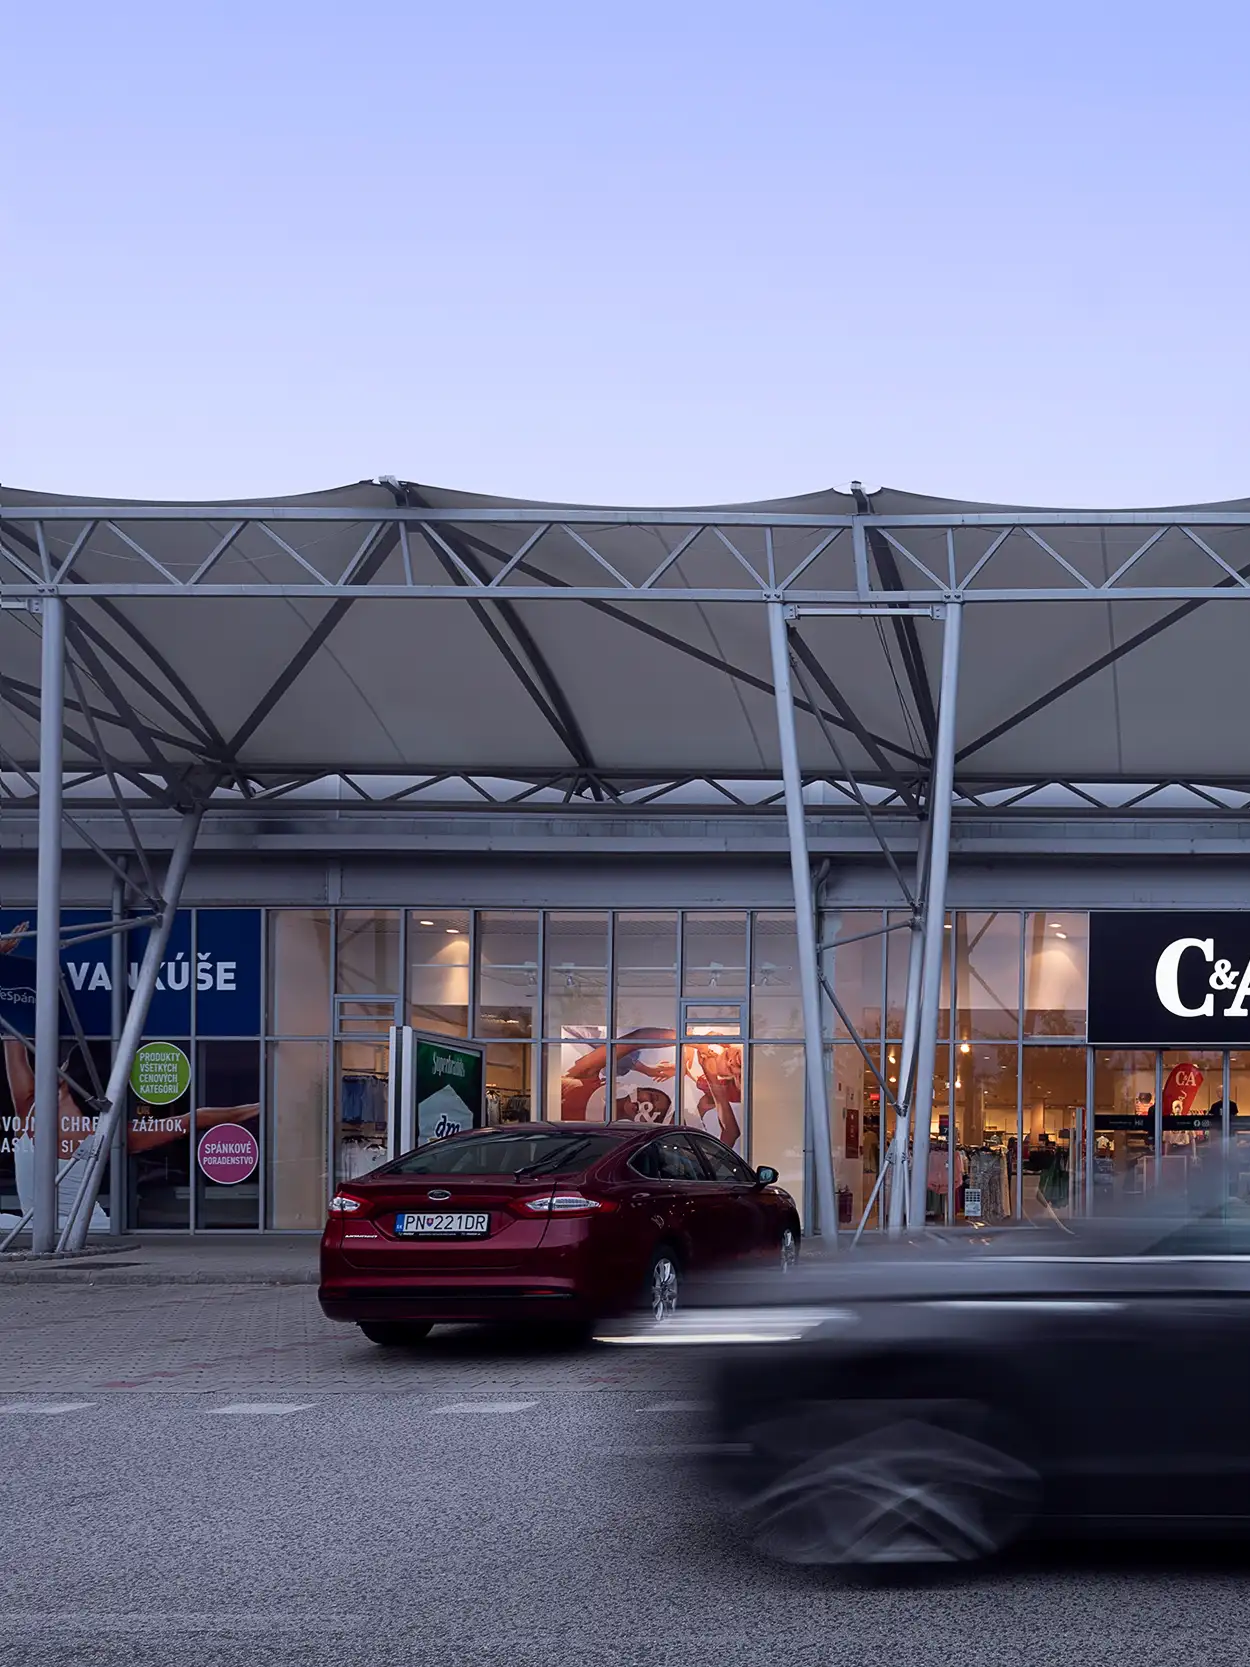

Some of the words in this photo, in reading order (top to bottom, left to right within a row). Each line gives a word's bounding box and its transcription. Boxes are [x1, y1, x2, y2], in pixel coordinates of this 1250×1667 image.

[66, 952, 237, 991] VAÚŠE
[139, 1052, 180, 1062] PRODUKTY
[140, 1062, 178, 1072] VŠETKÝCH
[139, 1072, 178, 1082] CENOVÝCH
[1175, 1071, 1197, 1087] C&A
[132, 1115, 187, 1134] ZÁŽITOK,
[435, 1113, 461, 1138] dm
[61, 1139, 74, 1153] SI
[204, 1141, 252, 1154] SPÁNKOVÉ
[203, 1156, 254, 1165] PORADENSTVO
